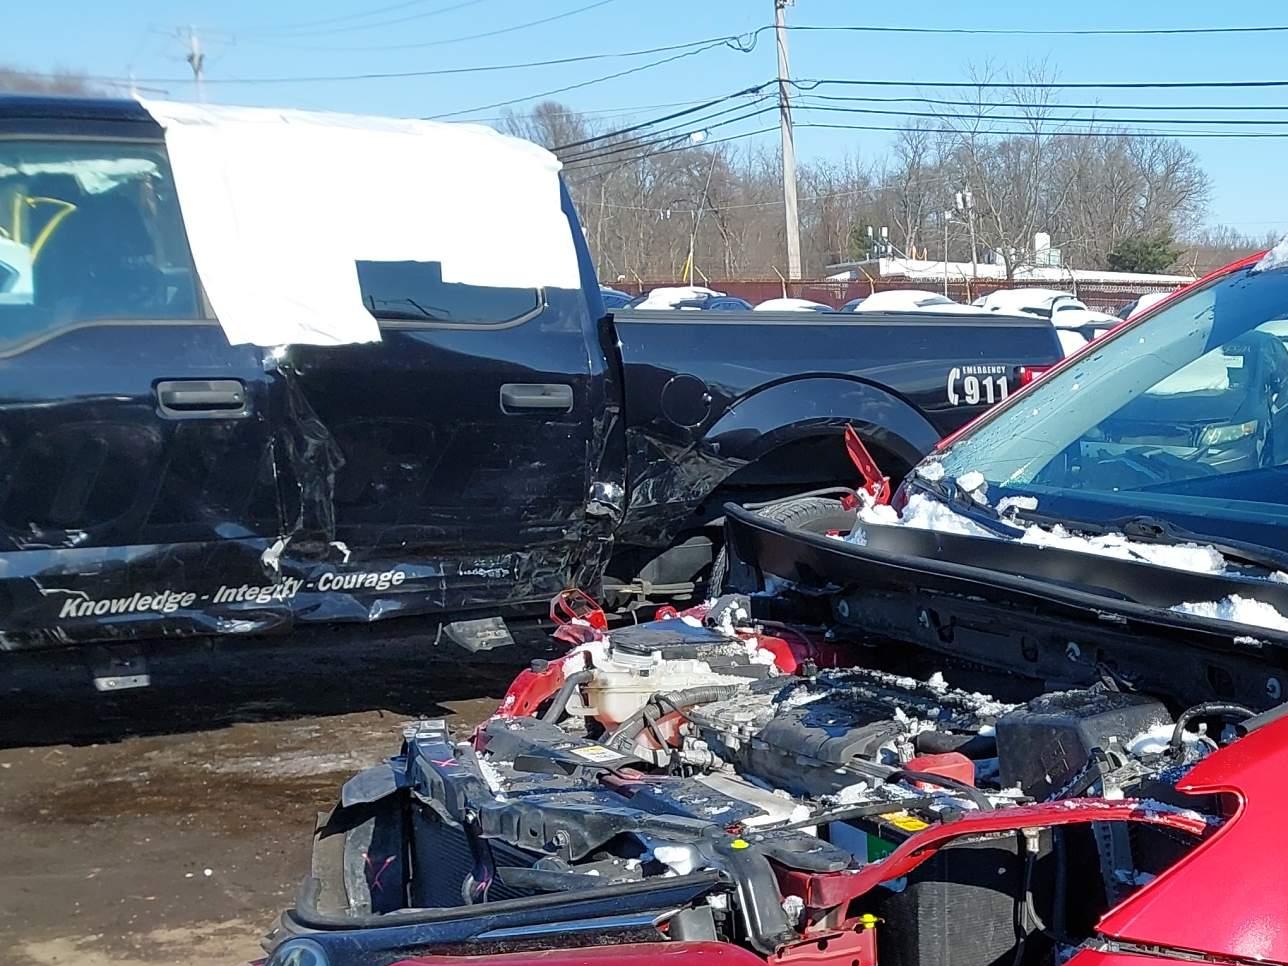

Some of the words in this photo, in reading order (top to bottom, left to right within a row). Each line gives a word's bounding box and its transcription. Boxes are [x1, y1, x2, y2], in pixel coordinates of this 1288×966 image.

[962, 366, 1006, 375] EMERGENCY
[964, 376, 1009, 405] 911
[59, 590, 197, 618] Knowledge
[212, 576, 304, 604] Integrity
[317, 569, 406, 592] Courage
